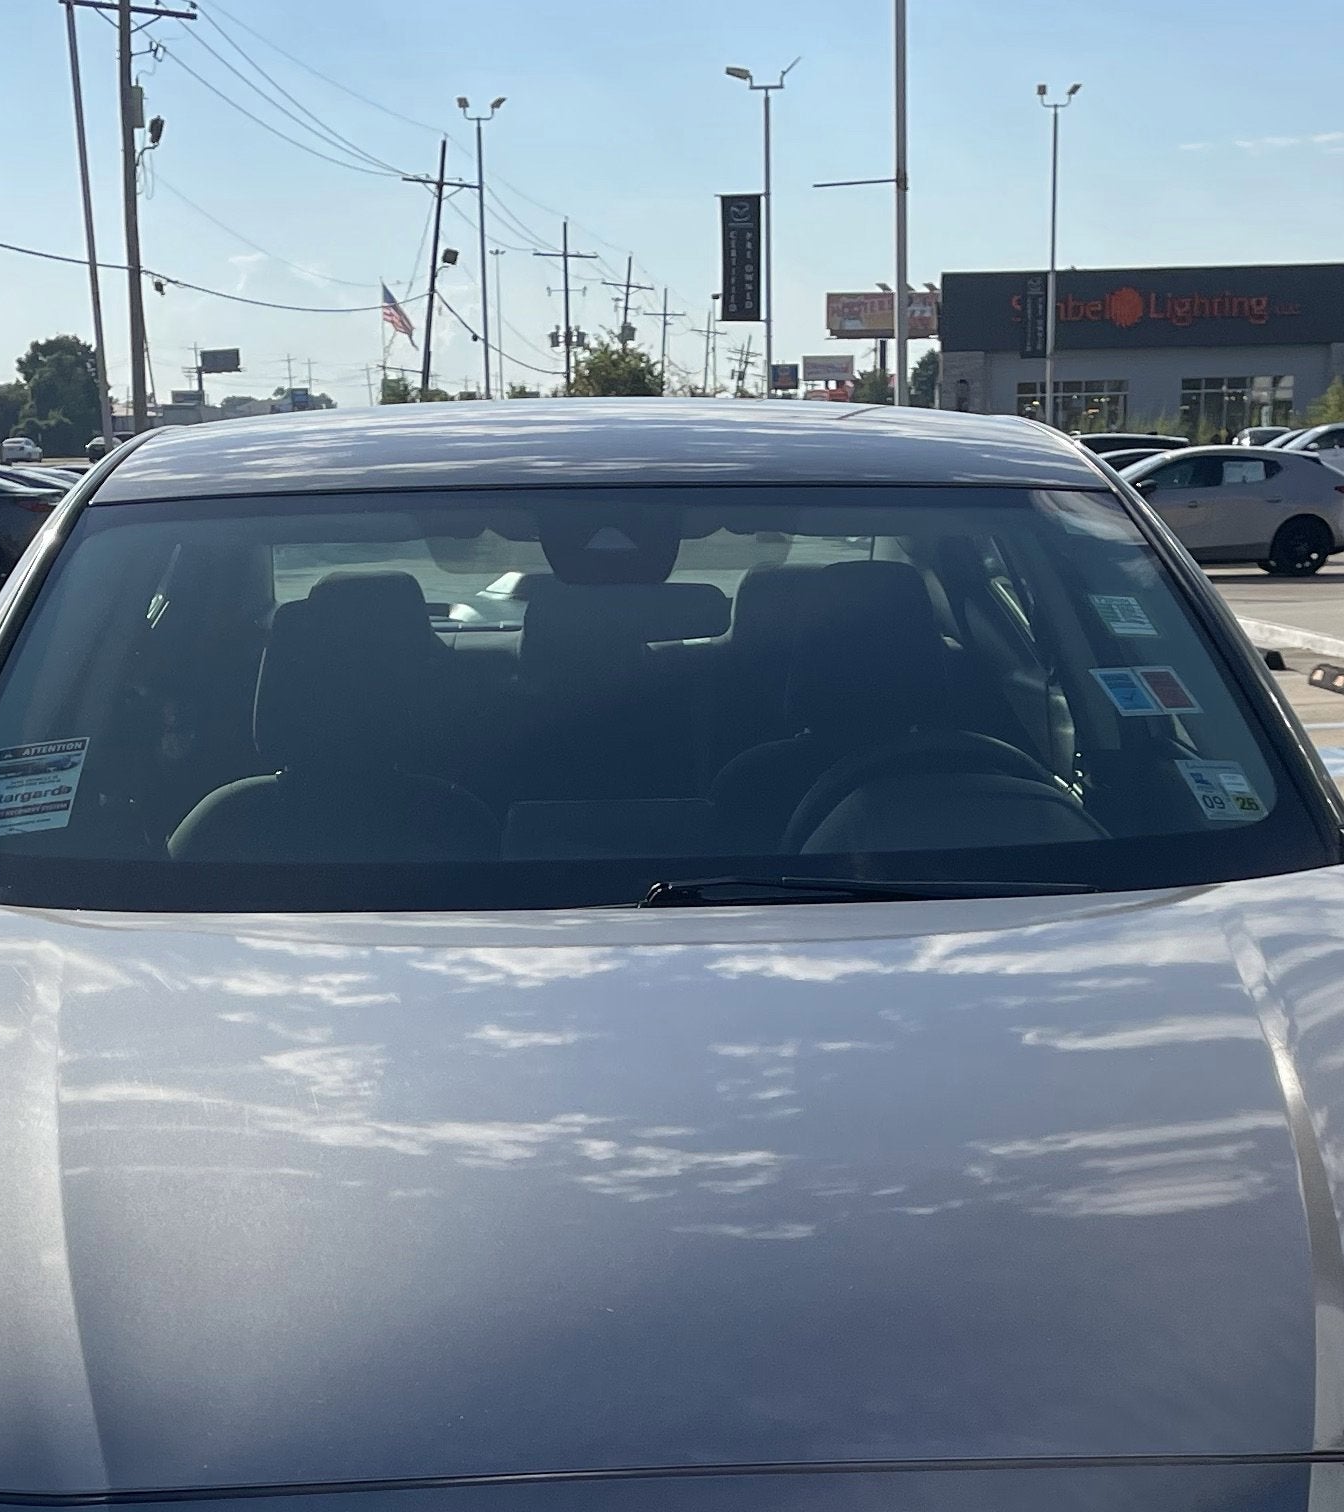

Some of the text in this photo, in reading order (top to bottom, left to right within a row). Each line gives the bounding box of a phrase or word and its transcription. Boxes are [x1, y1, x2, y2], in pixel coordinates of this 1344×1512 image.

[1150, 291, 1268, 326] Lighting
[22, 741, 83, 756] ATTENTION
[1202, 794, 1226, 810] 09
